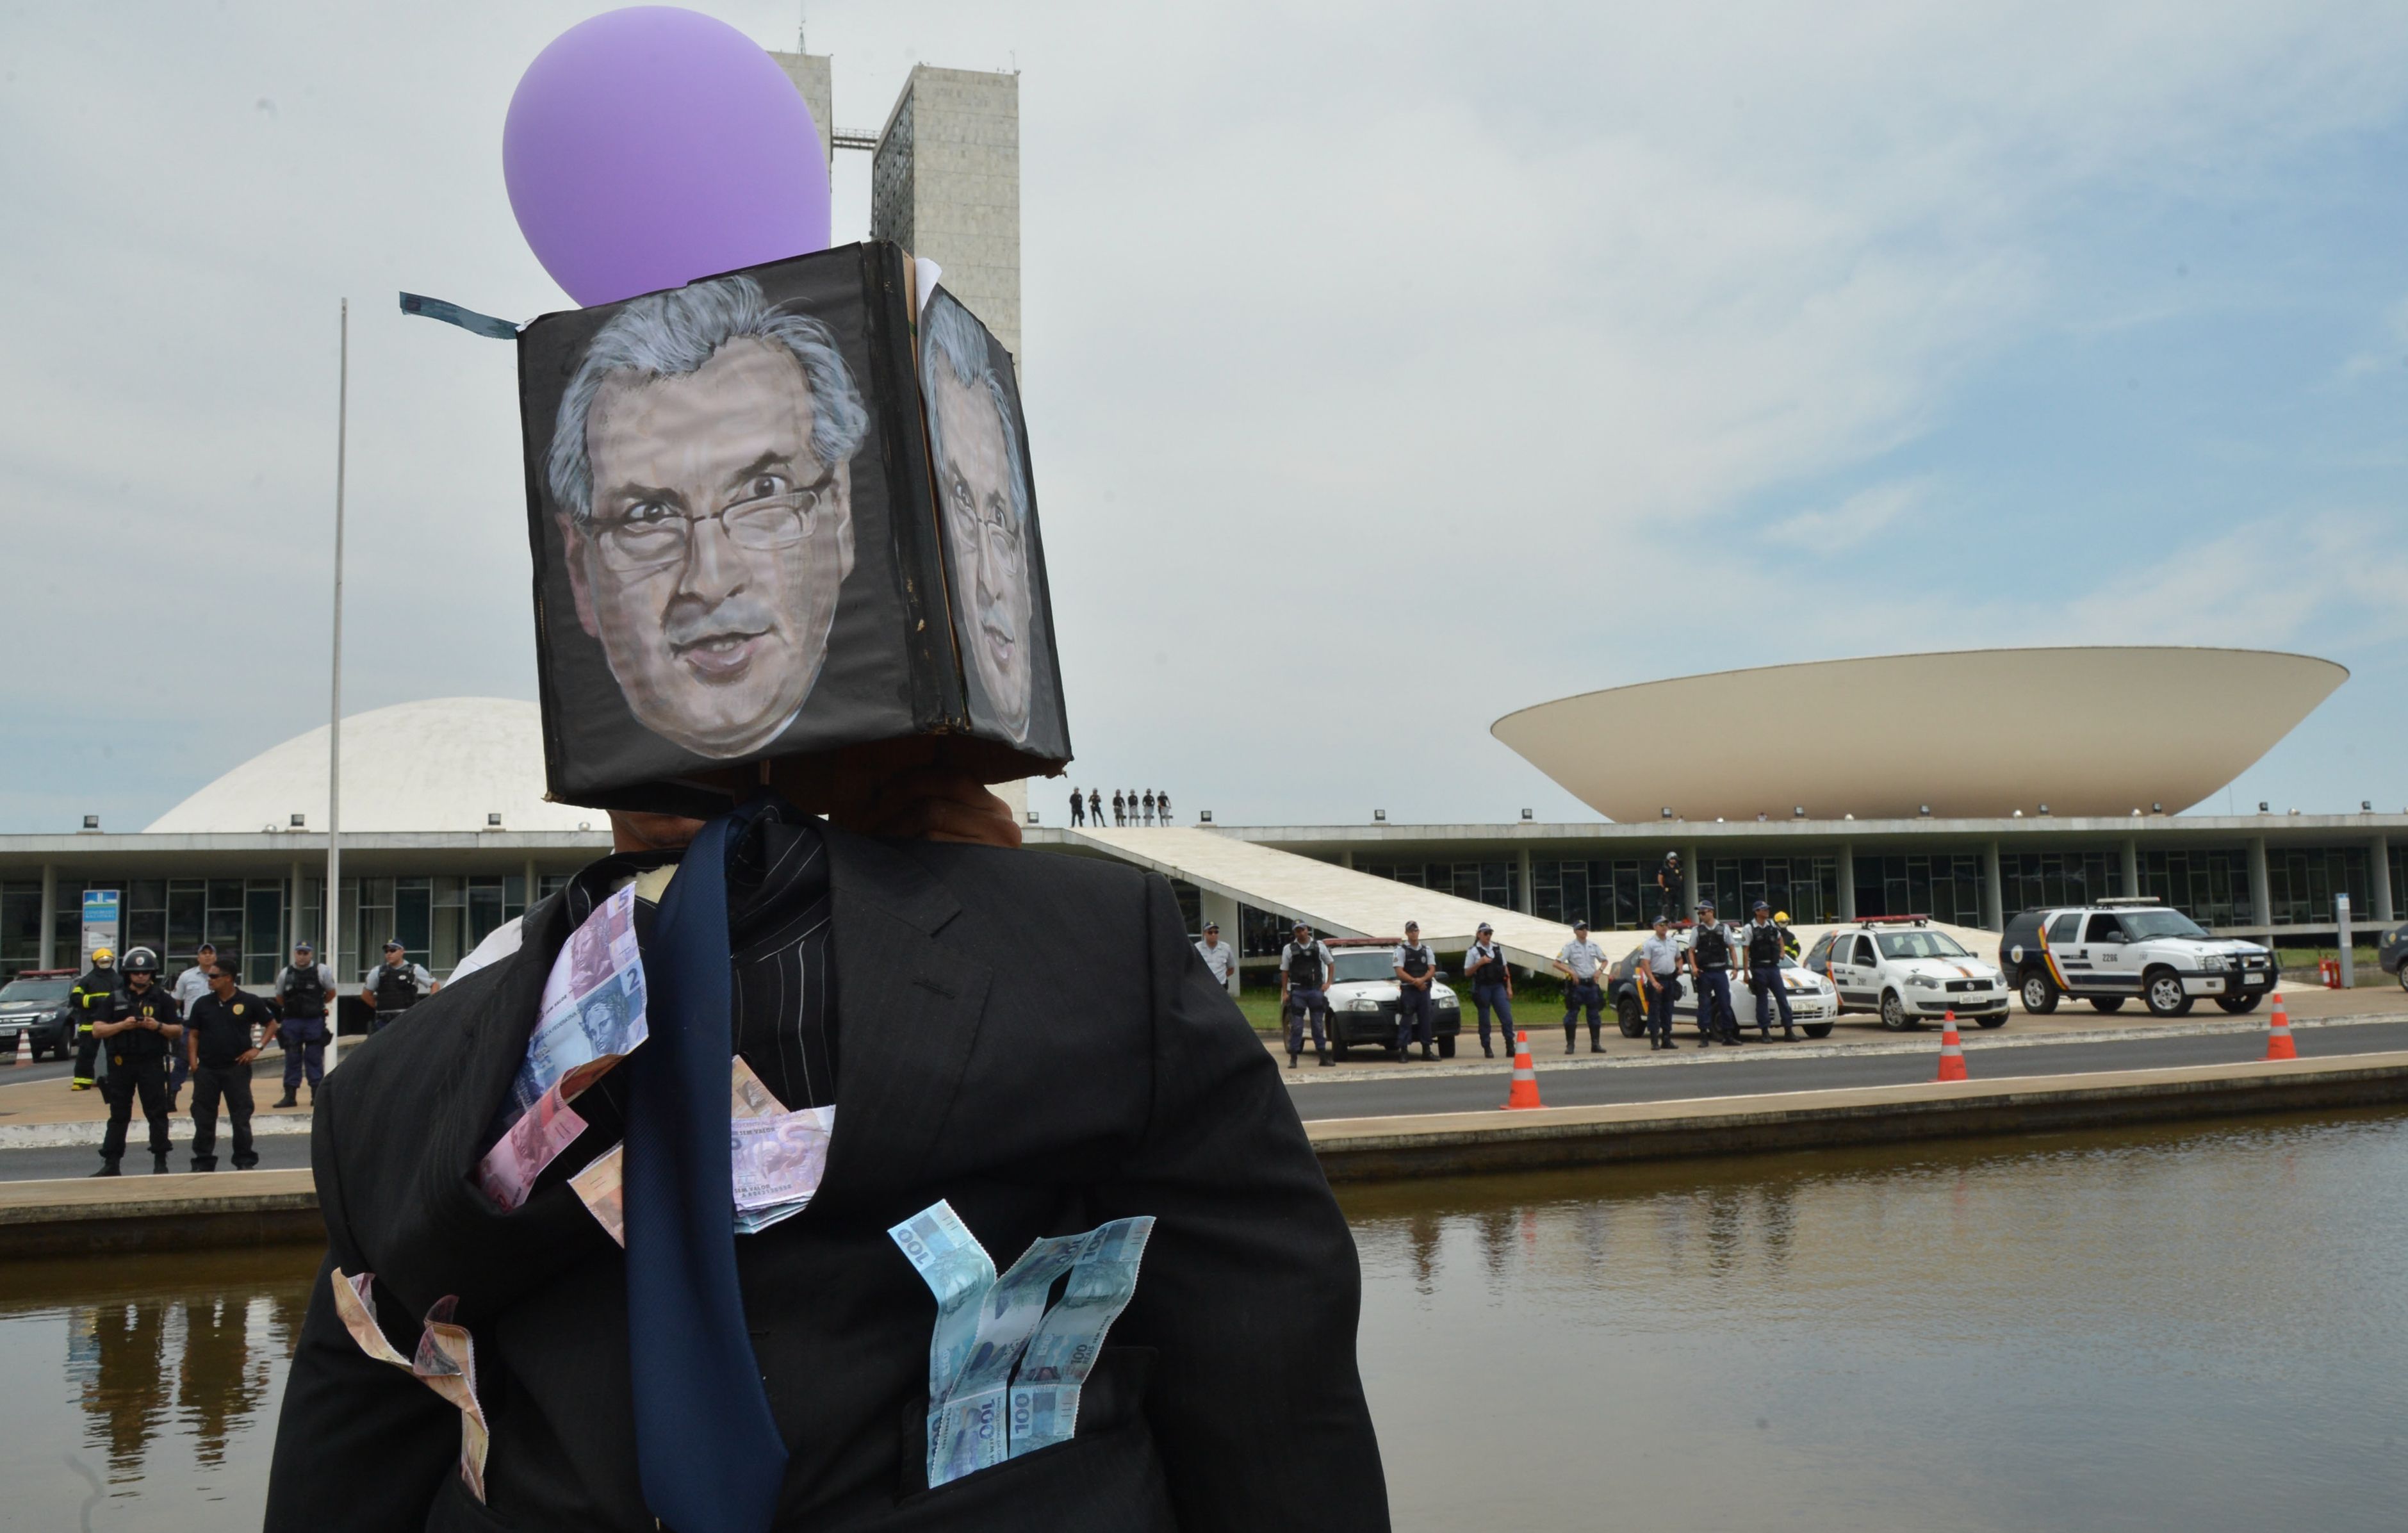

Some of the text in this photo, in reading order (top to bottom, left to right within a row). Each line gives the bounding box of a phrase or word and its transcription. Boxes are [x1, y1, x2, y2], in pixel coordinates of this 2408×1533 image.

[619, 889, 629, 909] 5
[2102, 953, 2118, 962] 2286
[627, 968, 640, 991] 2
[897, 1229, 929, 1265] 100
[1082, 1227, 1108, 1261] 100
[1070, 1344, 1088, 1365] 100
[1083, 1345, 1095, 1365] REAIS
[978, 1398, 995, 1439] 100
[1015, 1393, 1029, 1434] 100
